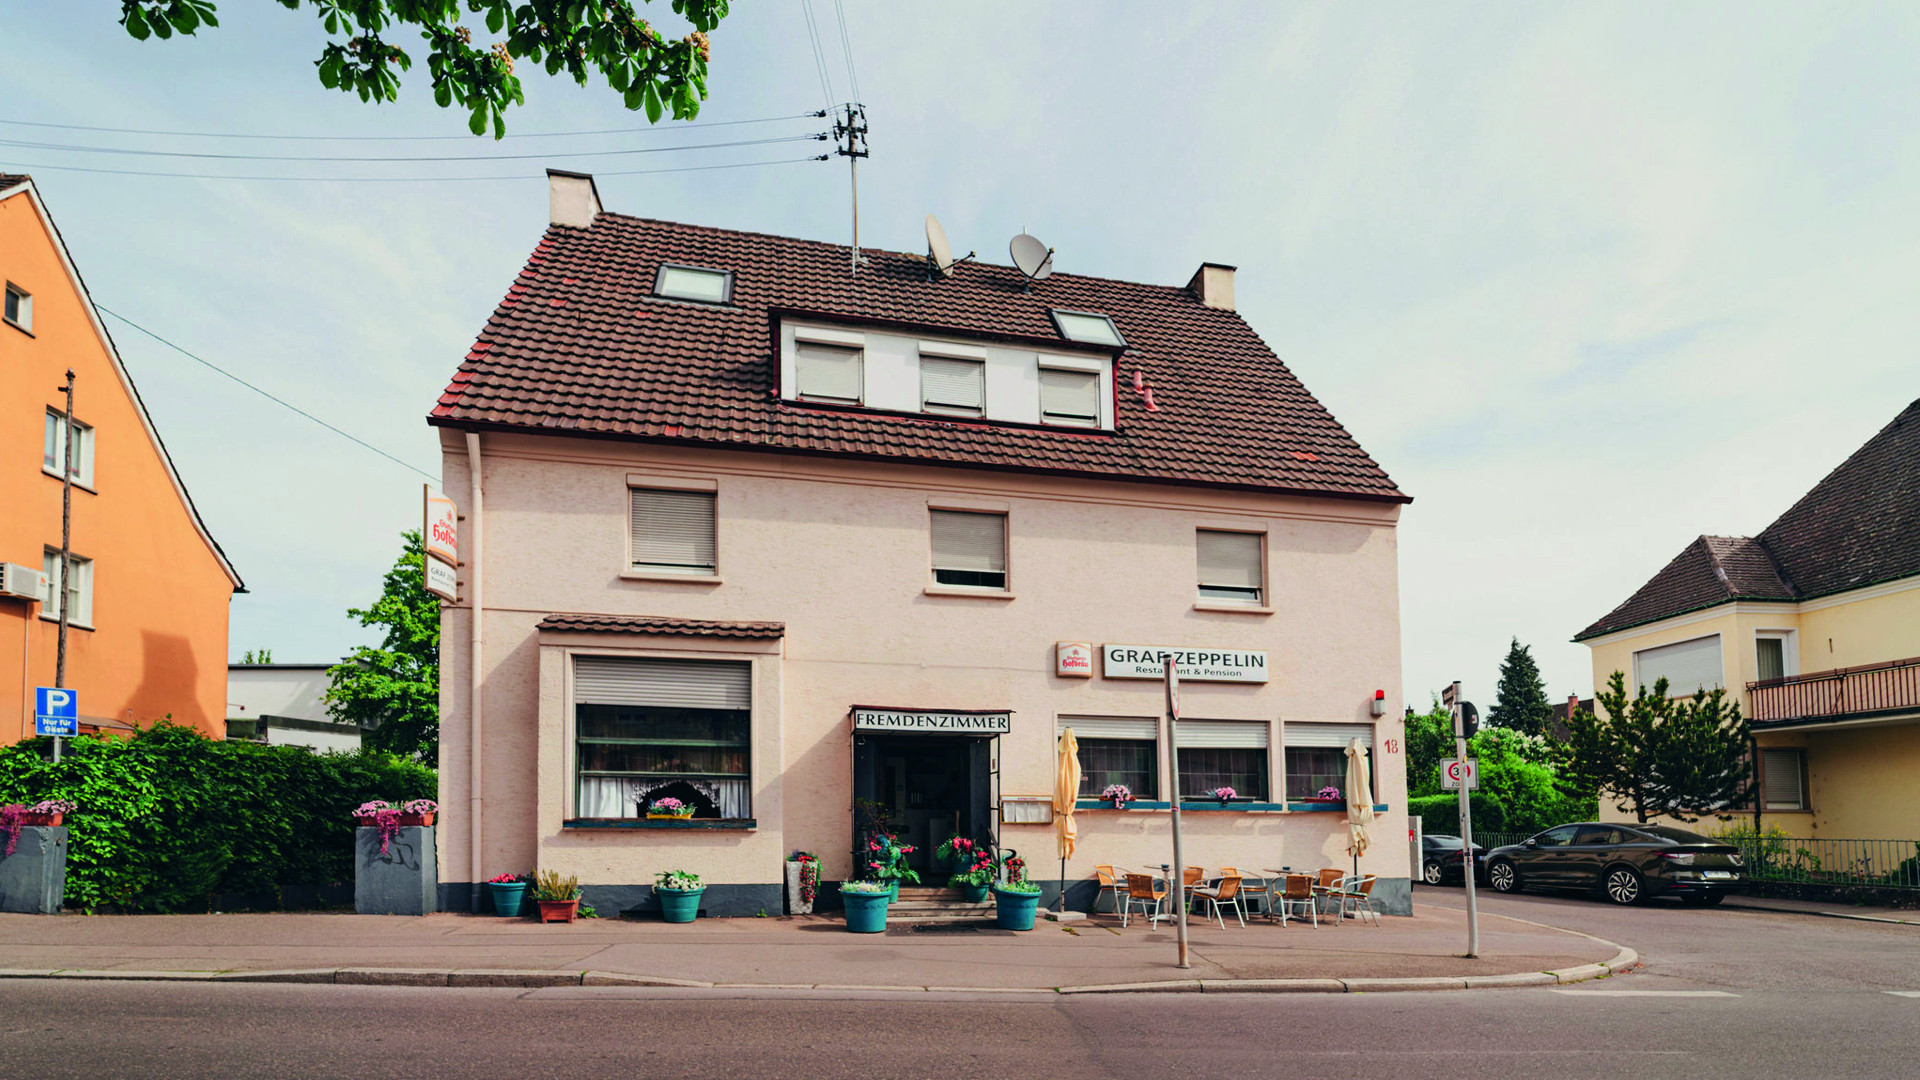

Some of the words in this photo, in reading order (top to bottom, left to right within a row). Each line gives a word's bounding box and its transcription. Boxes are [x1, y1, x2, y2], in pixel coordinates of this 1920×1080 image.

[1110, 649, 1166, 664] GRAF
[1173, 651, 1264, 668] ZEPPELIN
[1135, 666, 1190, 675] Restant
[1204, 668, 1242, 677] Pension
[47, 690, 70, 715] P
[43, 718, 57, 726] Nur
[856, 713, 1007, 729] FREMDENZIMMER
[1384, 739, 1399, 753] 18
